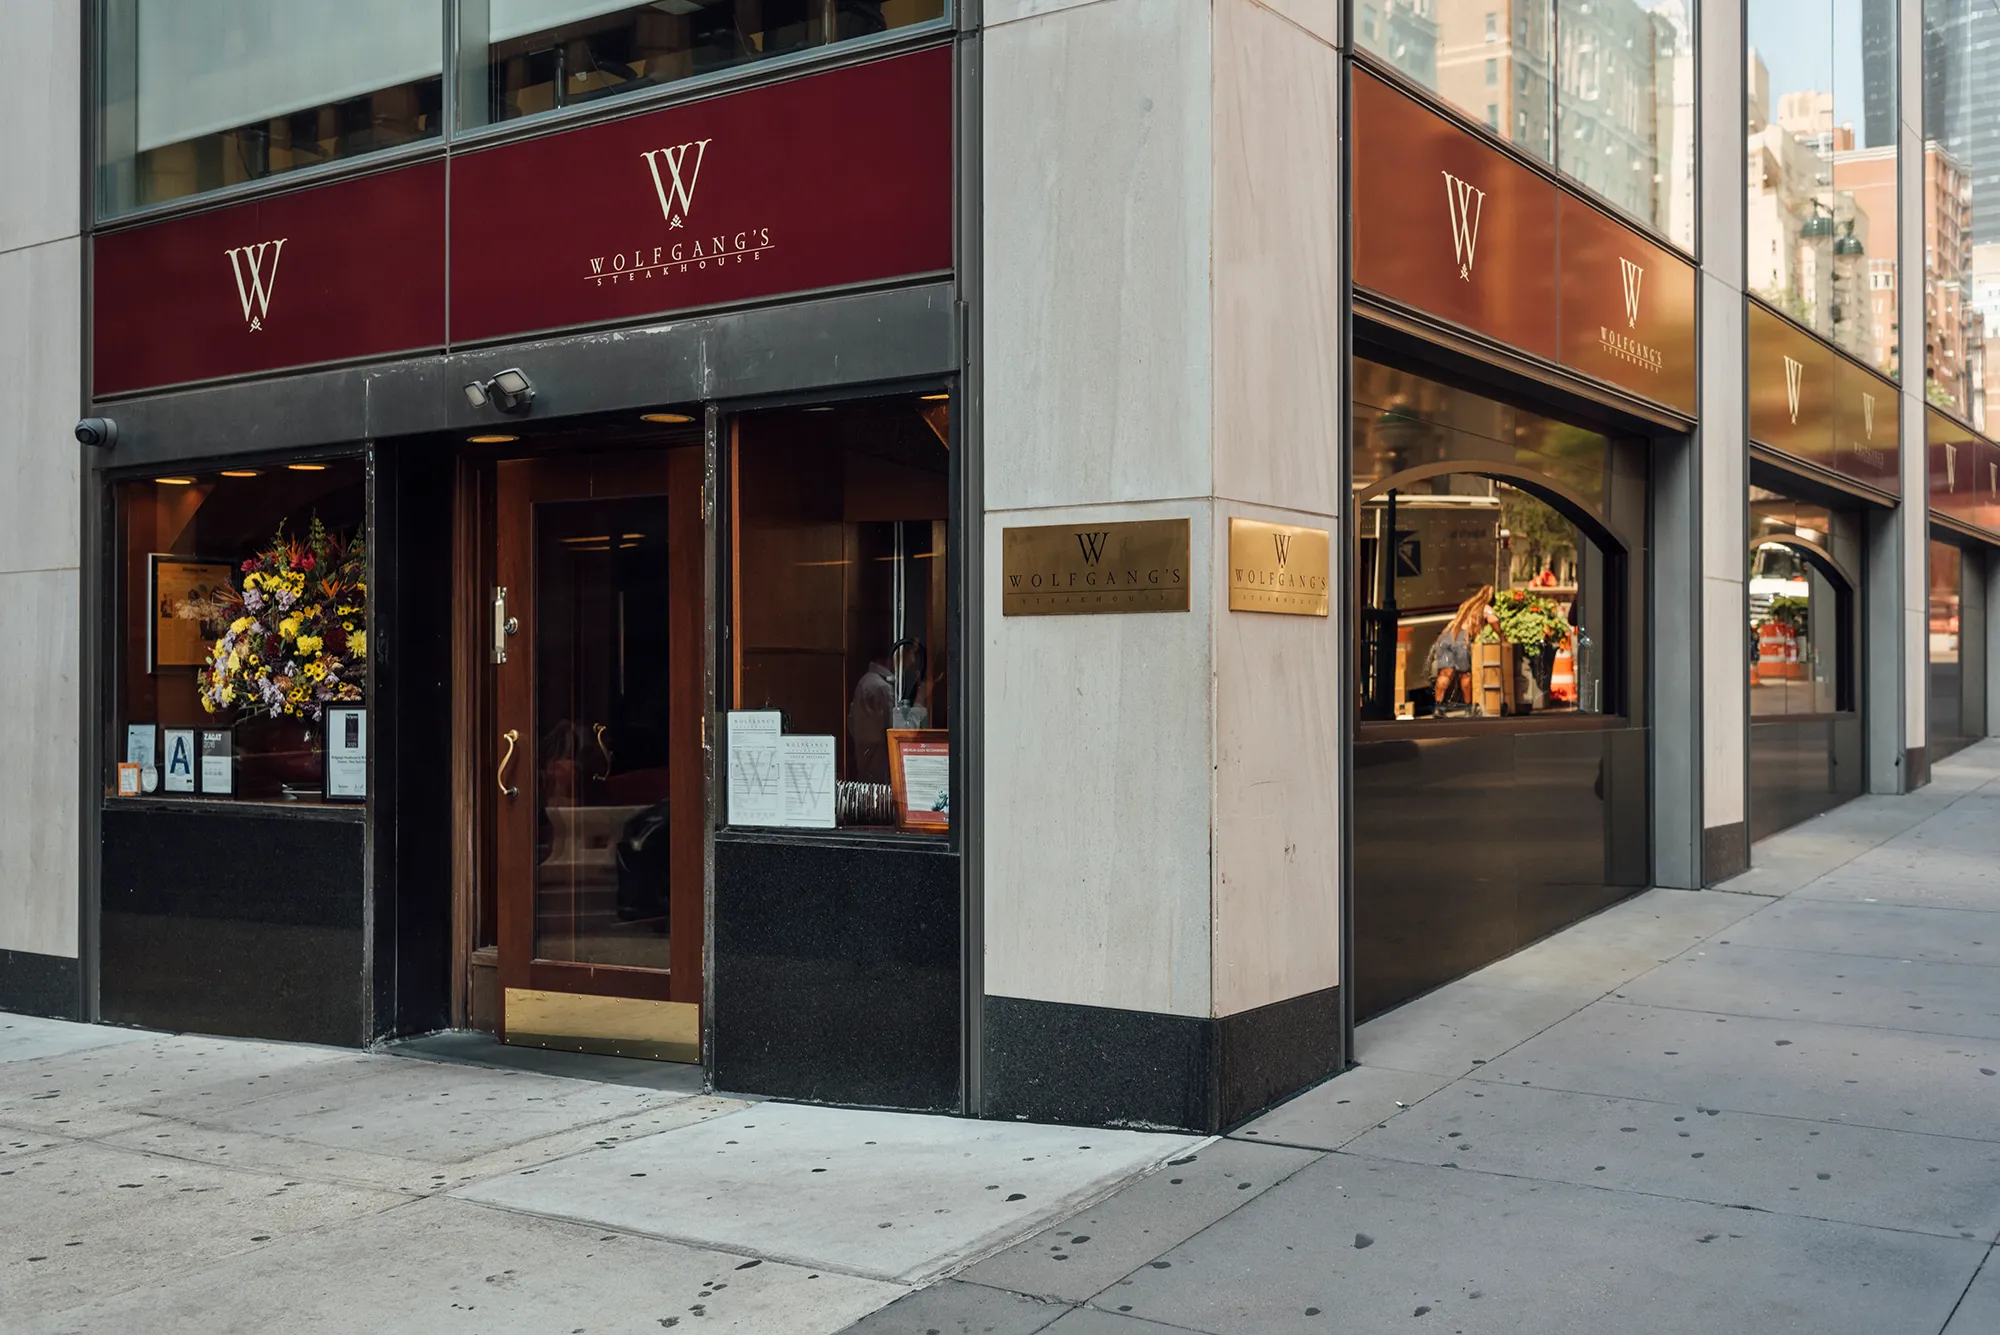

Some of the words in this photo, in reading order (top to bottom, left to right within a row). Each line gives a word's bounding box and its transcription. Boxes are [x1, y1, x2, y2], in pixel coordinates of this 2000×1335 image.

[640, 138, 712, 220] W
[1441, 170, 1486, 271] W
[590, 227, 770, 275] WOLFGANG'S
[597, 251, 760, 287] STEAKHOUSE
[224, 238, 288, 322] W
[1619, 256, 1644, 322] W
[1600, 326, 1662, 365] WOLFGANG'S
[1784, 355, 1803, 417] W
[1075, 531, 1110, 564] W
[1272, 533, 1292, 566] W
[1009, 569, 1181, 588] WOLFGANG'S
[1235, 568, 1326, 591] WOLFGANG'S
[169, 736, 190, 774] A
